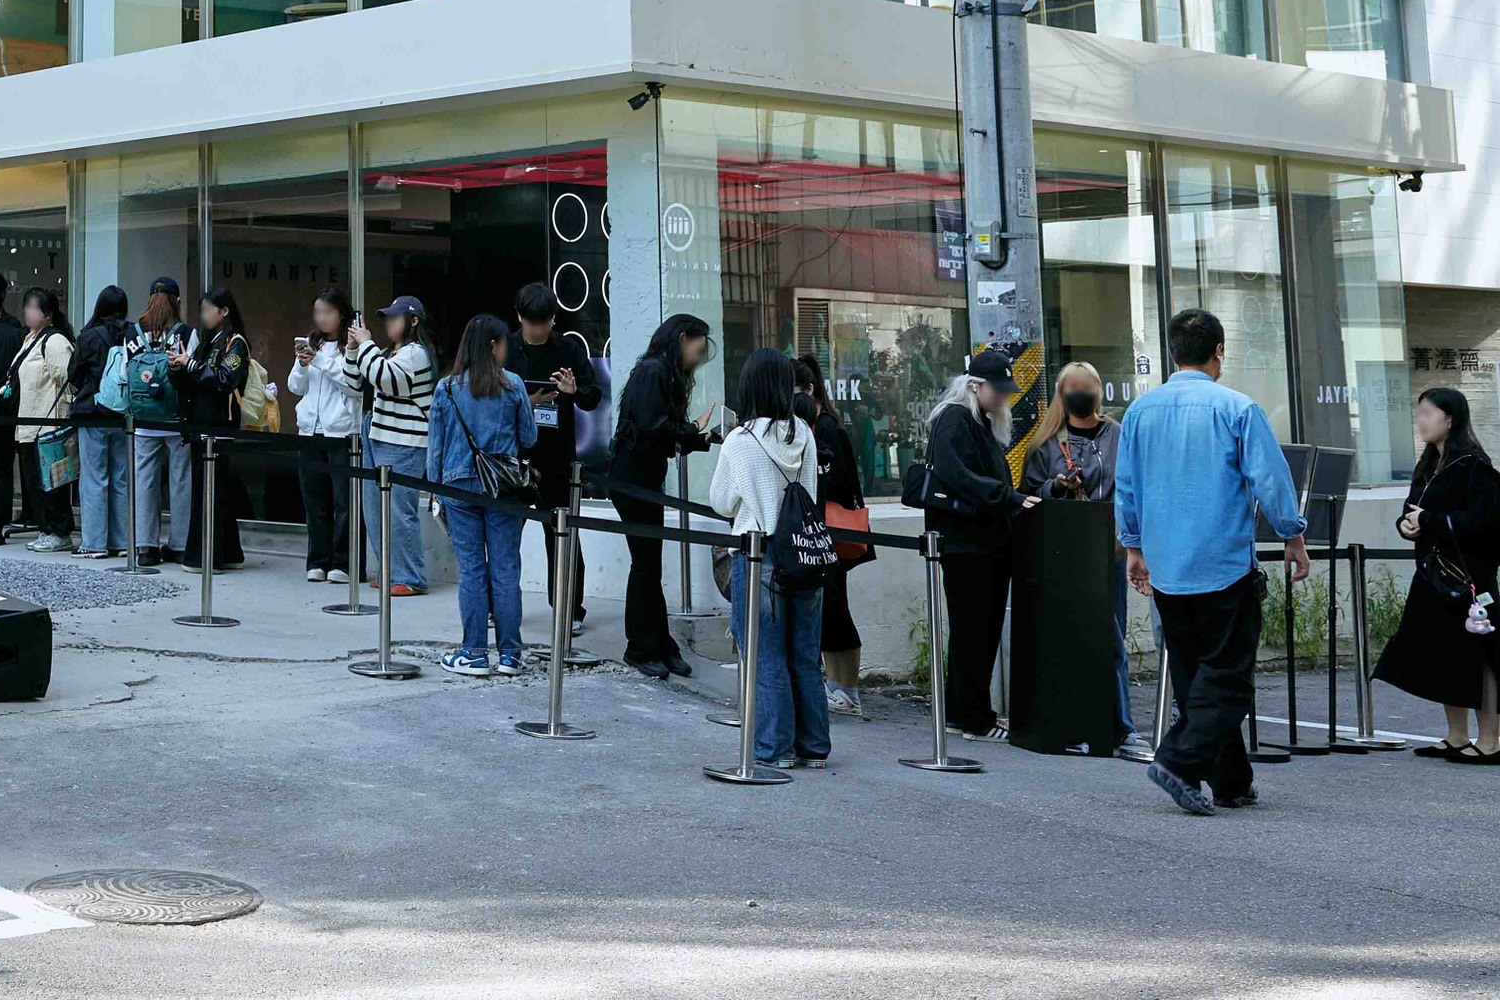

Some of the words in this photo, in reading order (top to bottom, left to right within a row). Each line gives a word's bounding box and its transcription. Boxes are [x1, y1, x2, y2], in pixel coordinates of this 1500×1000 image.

[824, 379, 862, 401] ARK
[540, 413, 551, 421] PD
[791, 533, 816, 549] More
